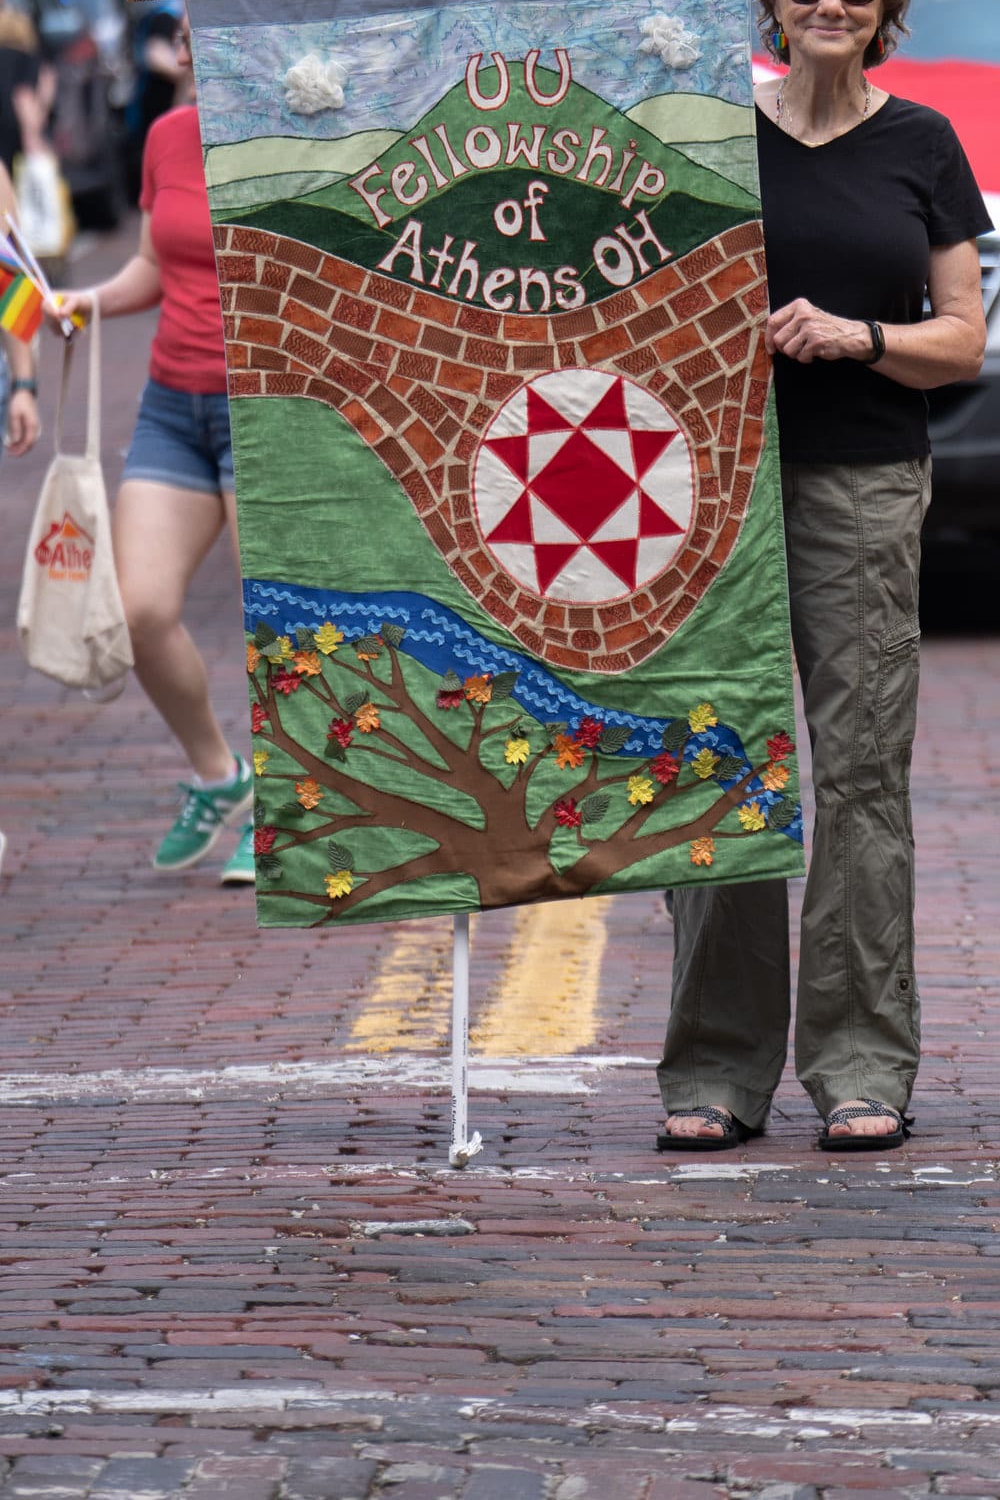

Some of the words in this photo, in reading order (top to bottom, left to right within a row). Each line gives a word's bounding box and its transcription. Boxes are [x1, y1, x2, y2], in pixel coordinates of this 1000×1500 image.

[465, 48, 573, 111] UU
[349, 122, 666, 229] Fellowship
[493, 180, 550, 241] of
[376, 218, 586, 312] Athens
[593, 209, 674, 287] OH
